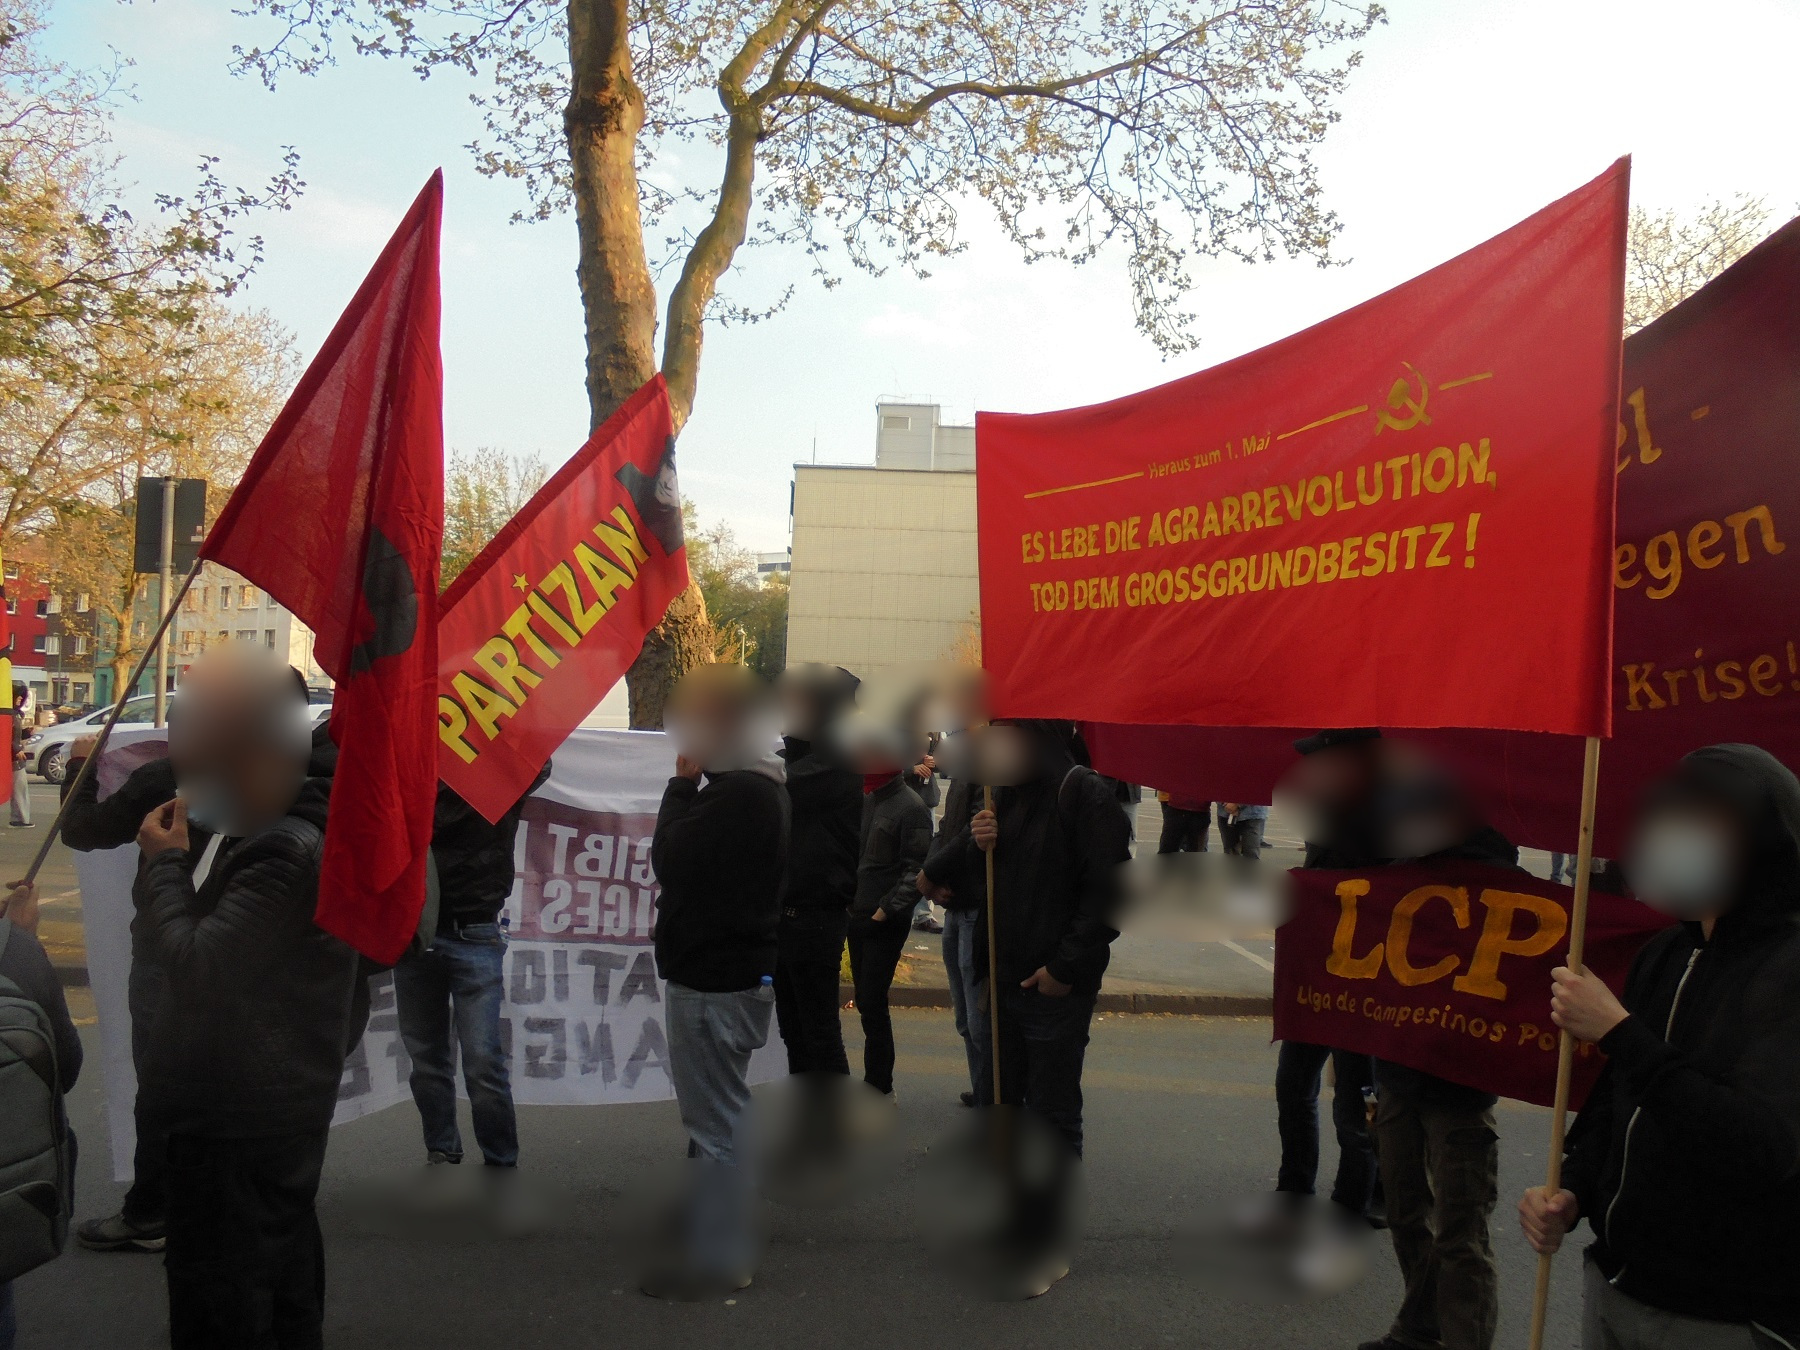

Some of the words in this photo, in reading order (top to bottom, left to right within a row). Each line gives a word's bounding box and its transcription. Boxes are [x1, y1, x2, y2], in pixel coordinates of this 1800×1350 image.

[1148, 457, 1192, 480] Heraus
[1193, 448, 1222, 470] zum
[1225, 441, 1239, 460] 1.
[1241, 431, 1271, 457] Mai
[1021, 530, 1046, 564] ES
[1049, 524, 1102, 561] LEBE
[1105, 515, 1142, 555] DIE
[1147, 437, 1499, 548] AGRARREVOLUTION,
[1029, 580, 1071, 612] TOD
[1073, 575, 1121, 611] DEM
[1613, 504, 1786, 600] egen
[438, 503, 652, 764] PARTIZAN
[1622, 641, 1800, 711] Krise!
[1326, 877, 1568, 1001] LCP
[1296, 985, 1332, 1013] Liga
[1336, 990, 1356, 1013] de
[1362, 997, 1507, 1043] Campesinos
[1518, 1023, 1610, 1058] Por
